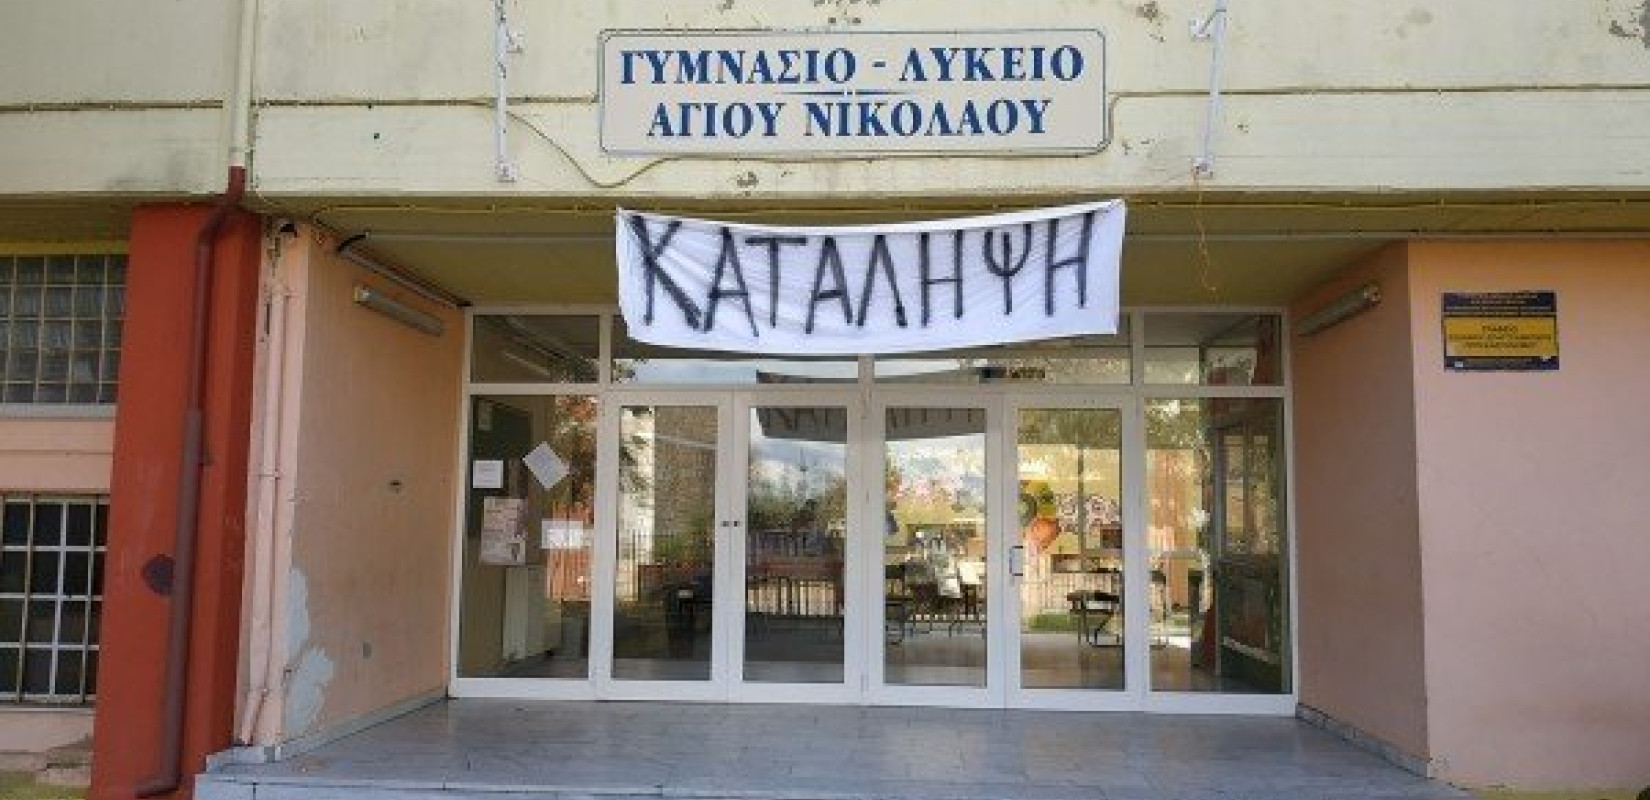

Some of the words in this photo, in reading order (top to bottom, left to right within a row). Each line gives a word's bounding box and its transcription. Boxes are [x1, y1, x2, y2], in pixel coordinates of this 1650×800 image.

[620, 47, 856, 84] ΓΥΜΝΑΣΙΟ
[899, 45, 1084, 82] ΛΥΚΕΙΟ
[647, 101, 785, 137] ΑΓΙΟΥ
[803, 98, 1051, 136] ΝΙΚΟΛΑΟΥ
[631, 212, 1094, 338] ΚΑΤΑΛΗΨΗ
